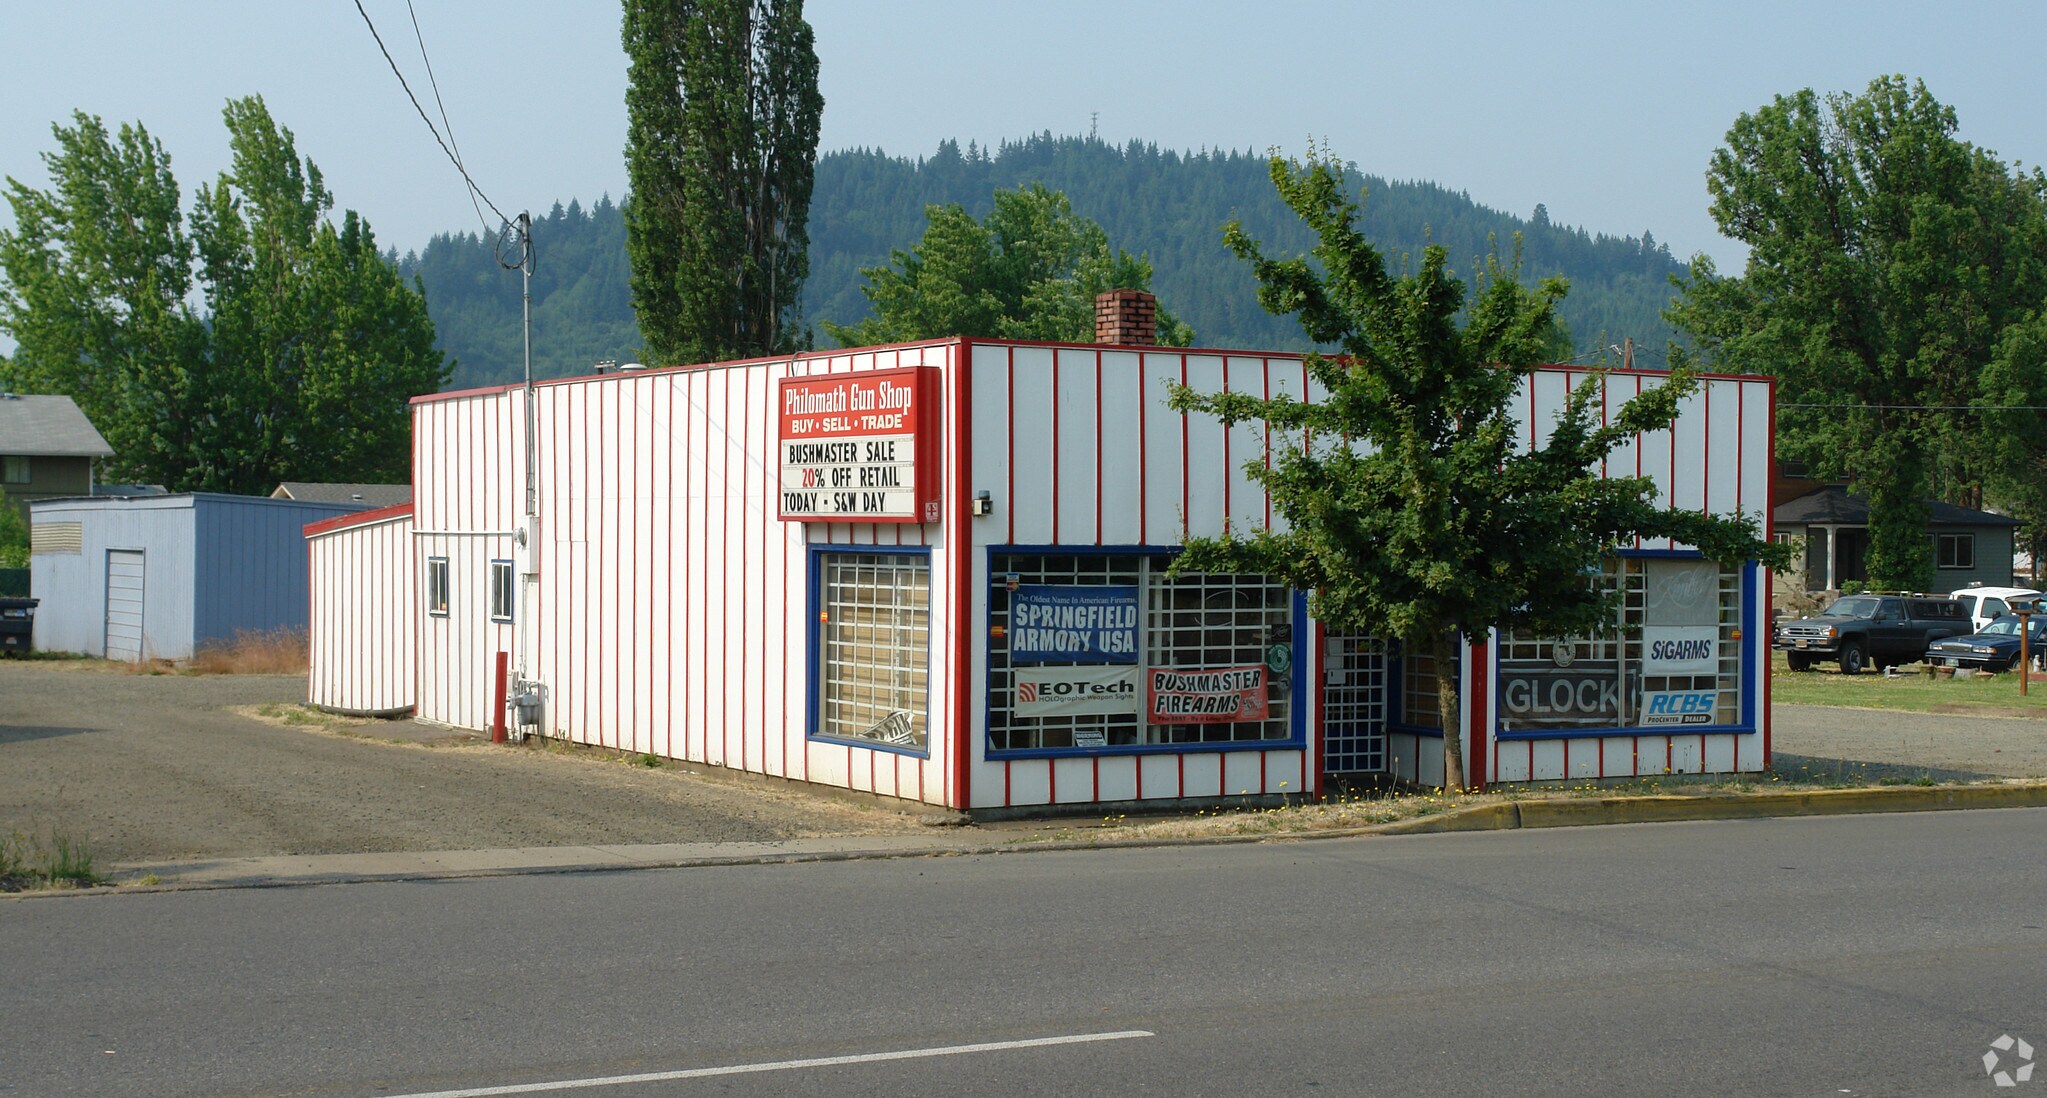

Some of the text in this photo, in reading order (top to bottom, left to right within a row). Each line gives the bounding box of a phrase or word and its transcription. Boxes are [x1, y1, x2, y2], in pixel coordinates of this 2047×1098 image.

[785, 380, 912, 416] Philomath Gun Shop
[791, 413, 902, 434] BUY SELL TRADE
[789, 440, 895, 464] BUSHMASTER SALE
[802, 466, 900, 488] 20% OFF RETAIL
[783, 491, 886, 513] TODAY S&W DAY
[1017, 593, 1029, 602] The
[1030, 594, 1050, 603] Oldest
[1051, 596, 1071, 604] Name
[1071, 596, 1078, 604] In
[1079, 596, 1110, 604] American
[1015, 603, 1137, 629] SPRINGFIELD
[1013, 628, 1092, 652] ARMORY
[1098, 630, 1135, 653] USA
[1038, 679, 1134, 695] EOTech
[1154, 668, 1262, 693] BUSHMASTER
[1038, 693, 1134, 703] HOLOgraphic Weapon Sights
[1154, 693, 1242, 715] FIREARMS
[1505, 678, 1619, 713] GLOCK
[1648, 693, 1716, 714] RCBS
